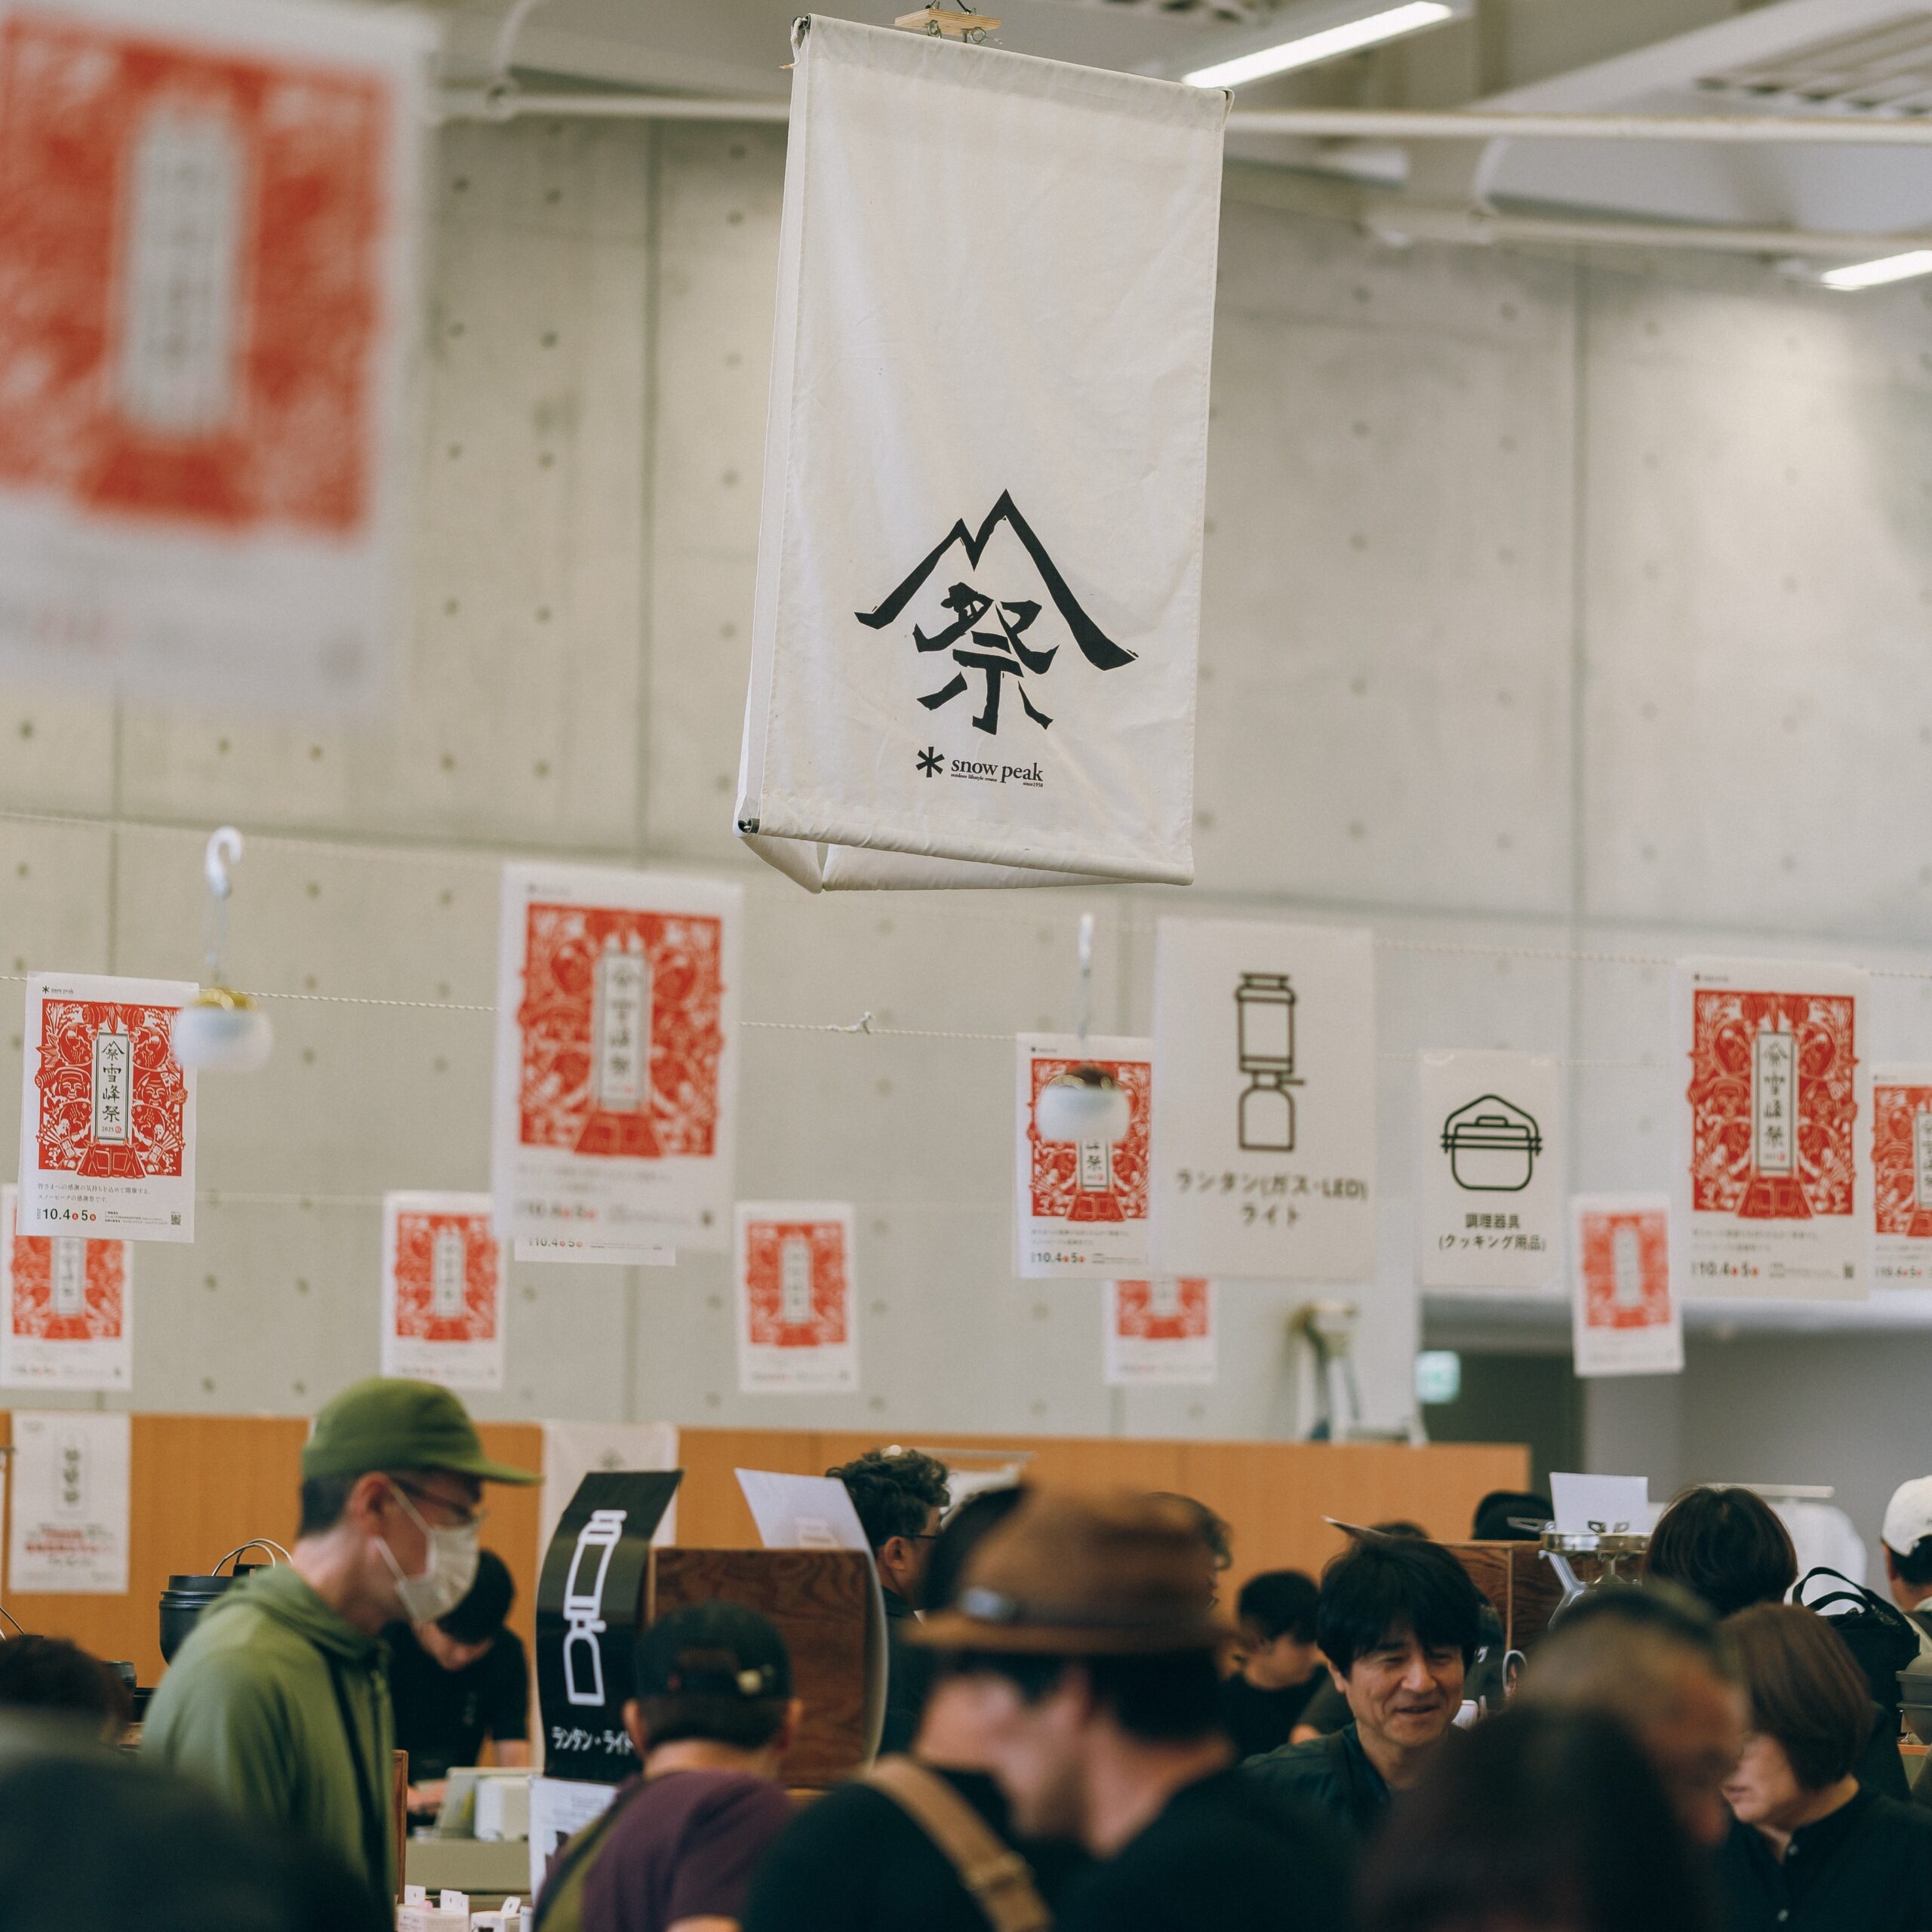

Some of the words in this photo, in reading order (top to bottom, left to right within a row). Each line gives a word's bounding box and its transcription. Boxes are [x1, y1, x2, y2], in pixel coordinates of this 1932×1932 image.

[912, 582, 1060, 735] 祭
[951, 759, 998, 776] snow
[1000, 762, 1044, 783] peak
[103, 1063, 122, 1122] 雪峰祭
[43, 1208, 70, 1220] 10.4
[1466, 1214, 1520, 1229] 調理器具
[1438, 1233, 1546, 1251] (クッキング用品)
[552, 1726, 633, 1755] ランタン・ライト
